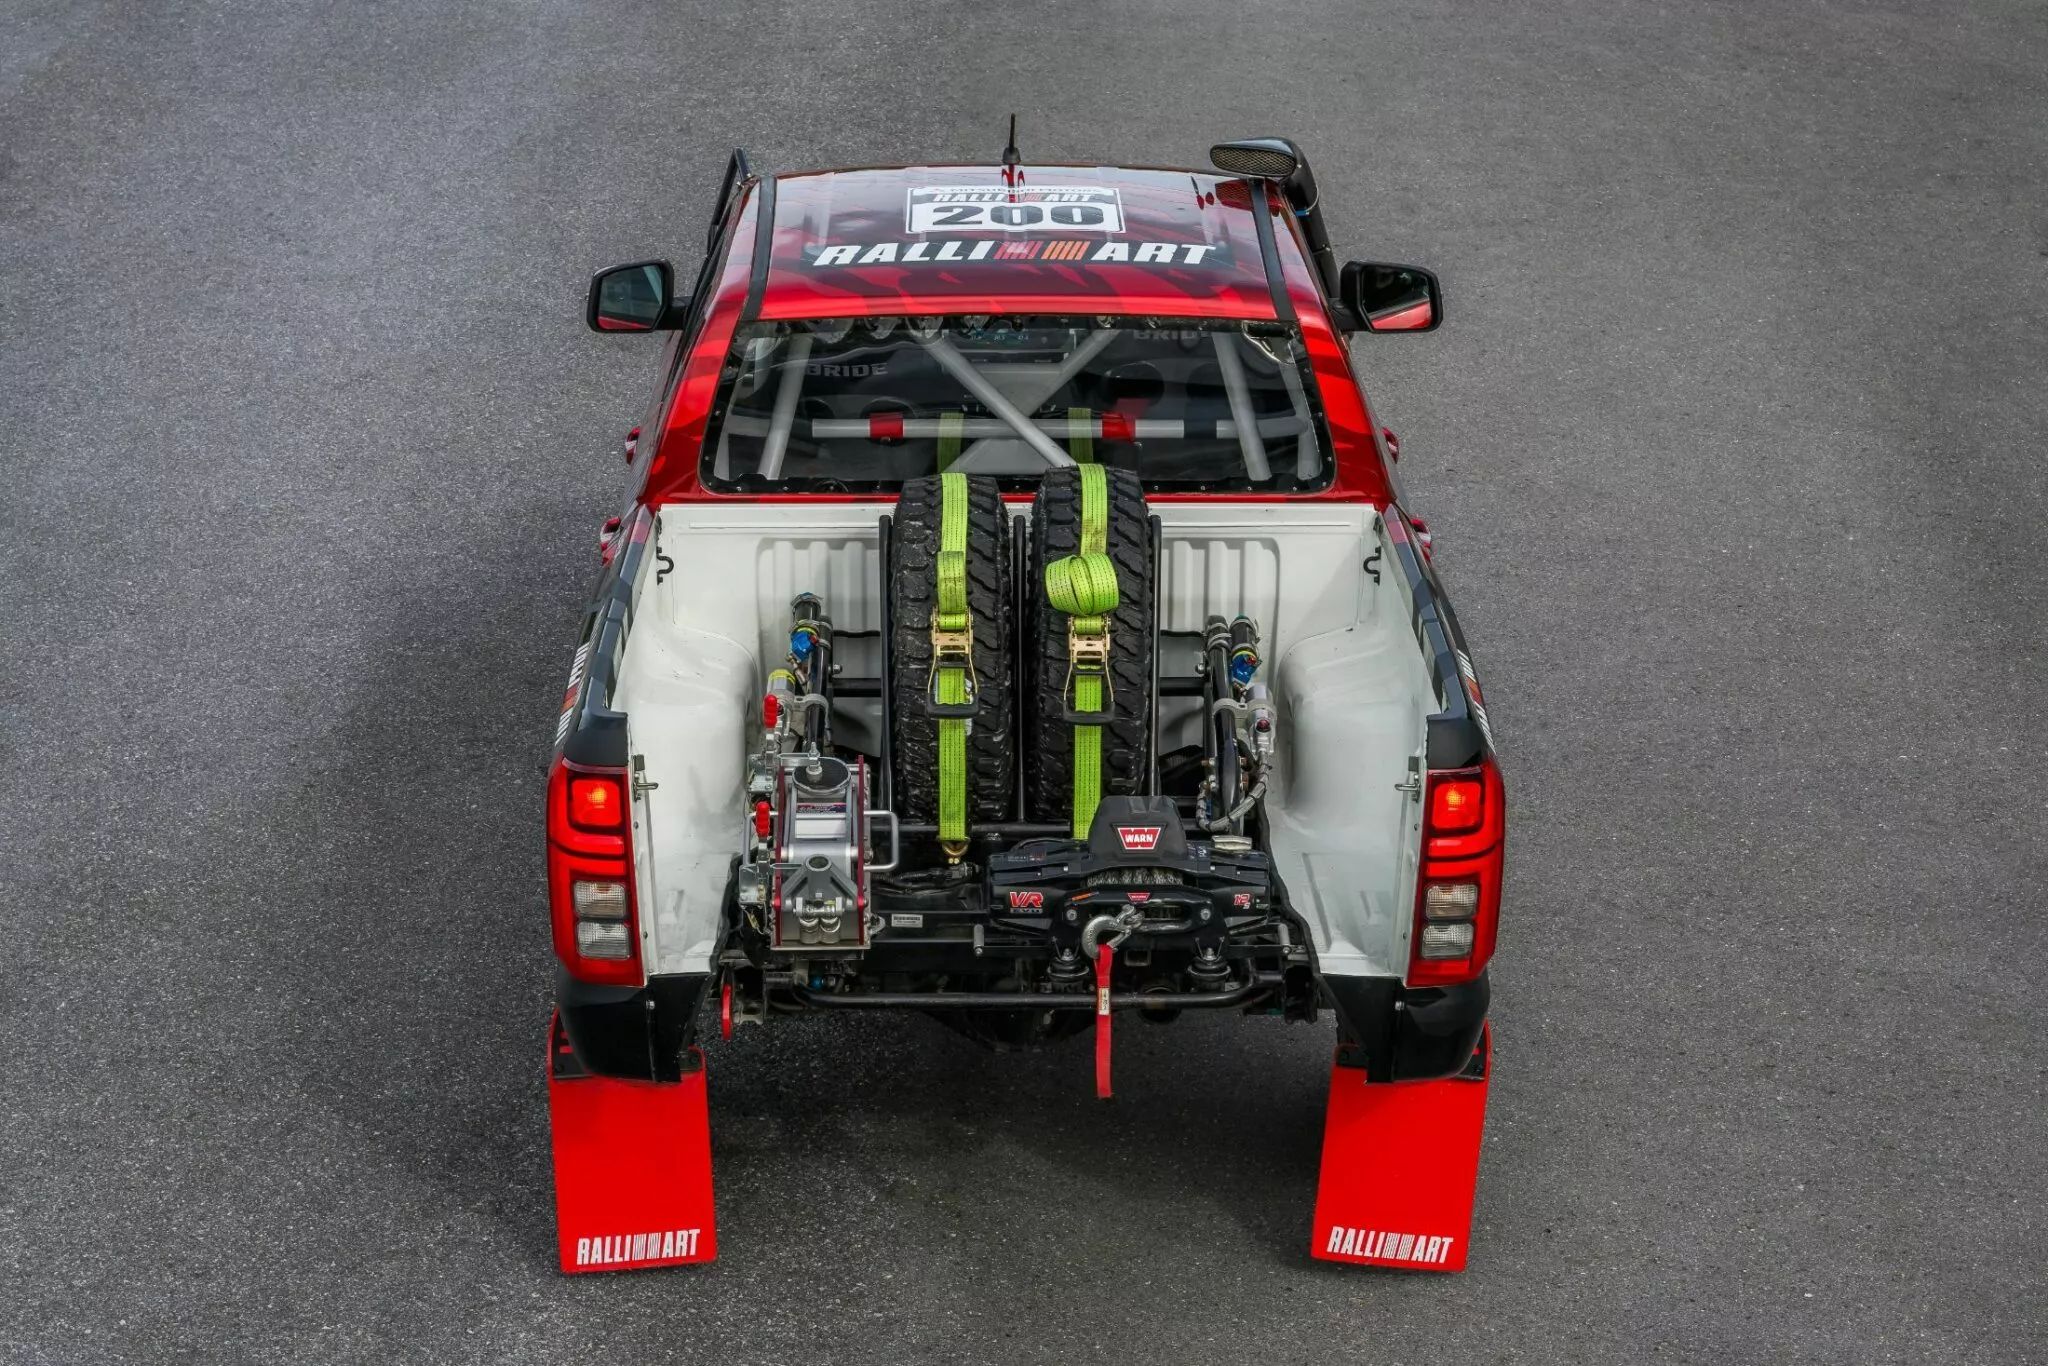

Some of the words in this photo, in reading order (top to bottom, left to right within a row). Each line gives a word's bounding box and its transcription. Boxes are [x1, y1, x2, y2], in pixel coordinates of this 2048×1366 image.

[932, 205, 1104, 225] 200
[806, 363, 888, 376] BRIDE
[1125, 834, 1153, 843] WARN
[1010, 891, 1043, 907] VR
